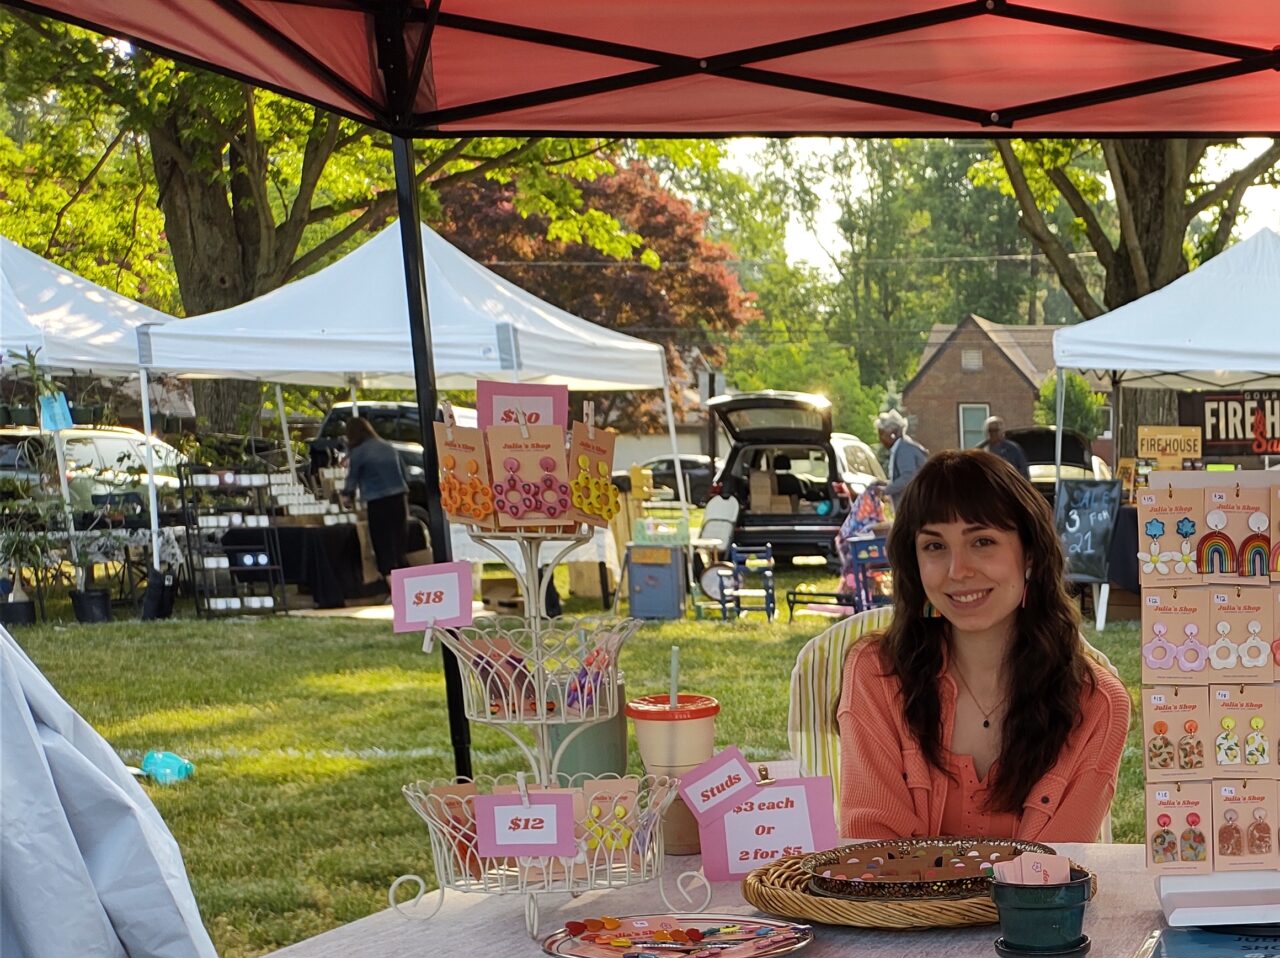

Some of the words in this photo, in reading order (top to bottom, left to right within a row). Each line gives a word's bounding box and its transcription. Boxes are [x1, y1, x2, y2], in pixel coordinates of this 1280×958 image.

[501, 409, 541, 425] $0
[1205, 400, 1256, 440] FIRE
[1140, 437, 1162, 452] FIRE
[1165, 438, 1198, 453] HOUSE
[1065, 509, 1080, 532] 3
[412, 590, 444, 607] $18
[700, 773, 742, 803] Studs
[733, 801, 755, 815] $3
[758, 797, 795, 811] each
[508, 816, 545, 832] $12
[755, 824, 776, 836] Or
[739, 851, 750, 861] 2
[753, 848, 779, 861] for
[782, 845, 803, 858] $5
